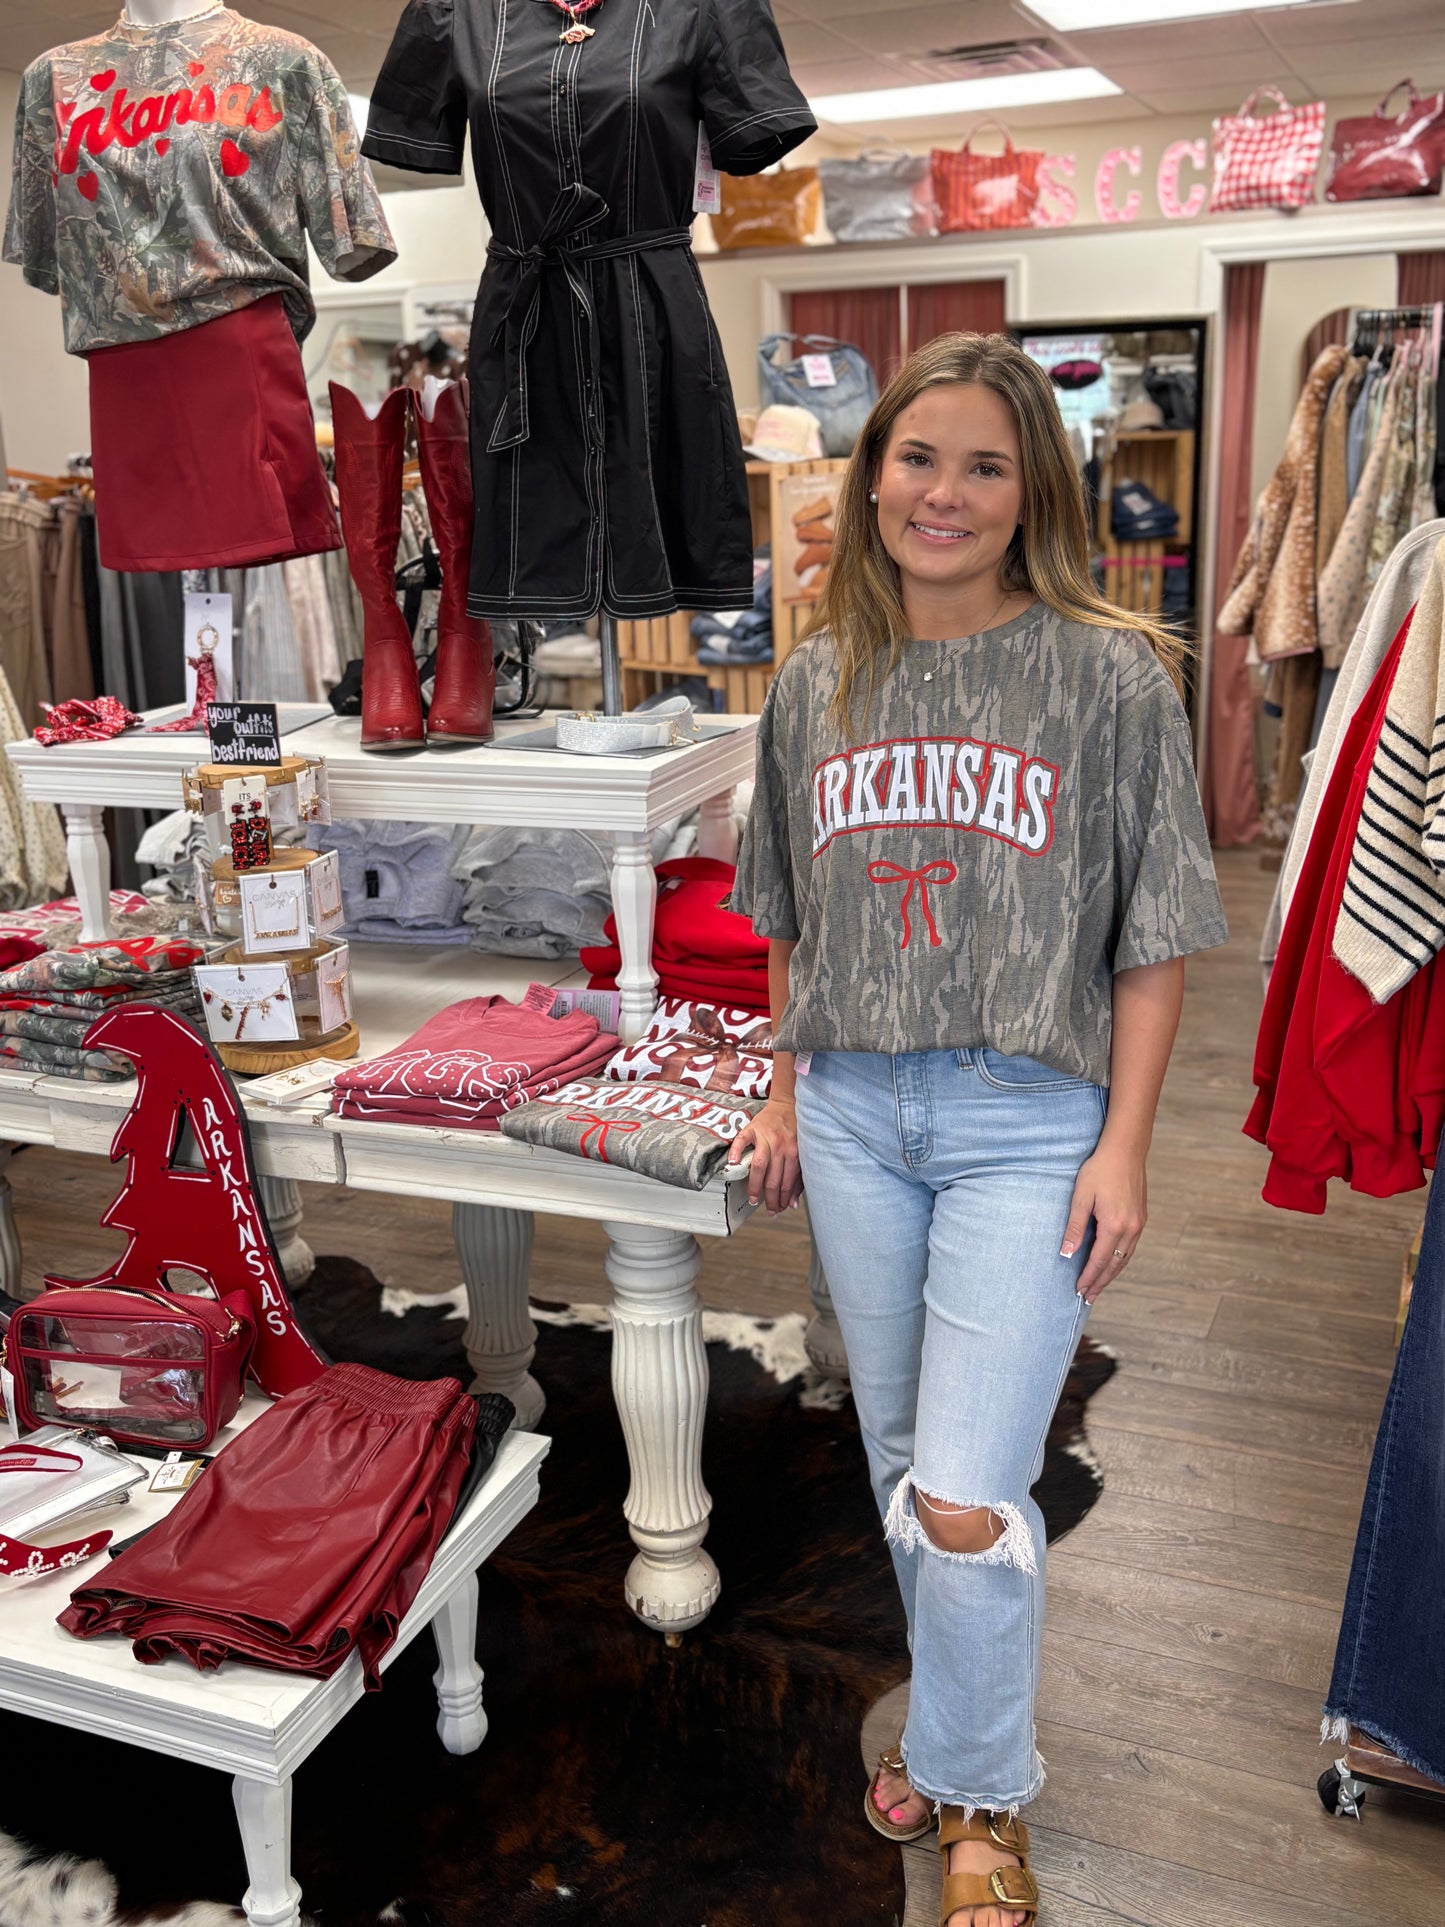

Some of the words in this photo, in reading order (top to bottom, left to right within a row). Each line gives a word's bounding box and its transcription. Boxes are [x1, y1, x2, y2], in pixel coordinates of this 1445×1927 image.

[207, 707, 241, 728] your
[812, 739, 1054, 852] ARKANSAS
[252, 890, 296, 902] CANVAS
[225, 987, 264, 996] CANVAS
[202, 1097, 287, 1336] ARKANSAS
